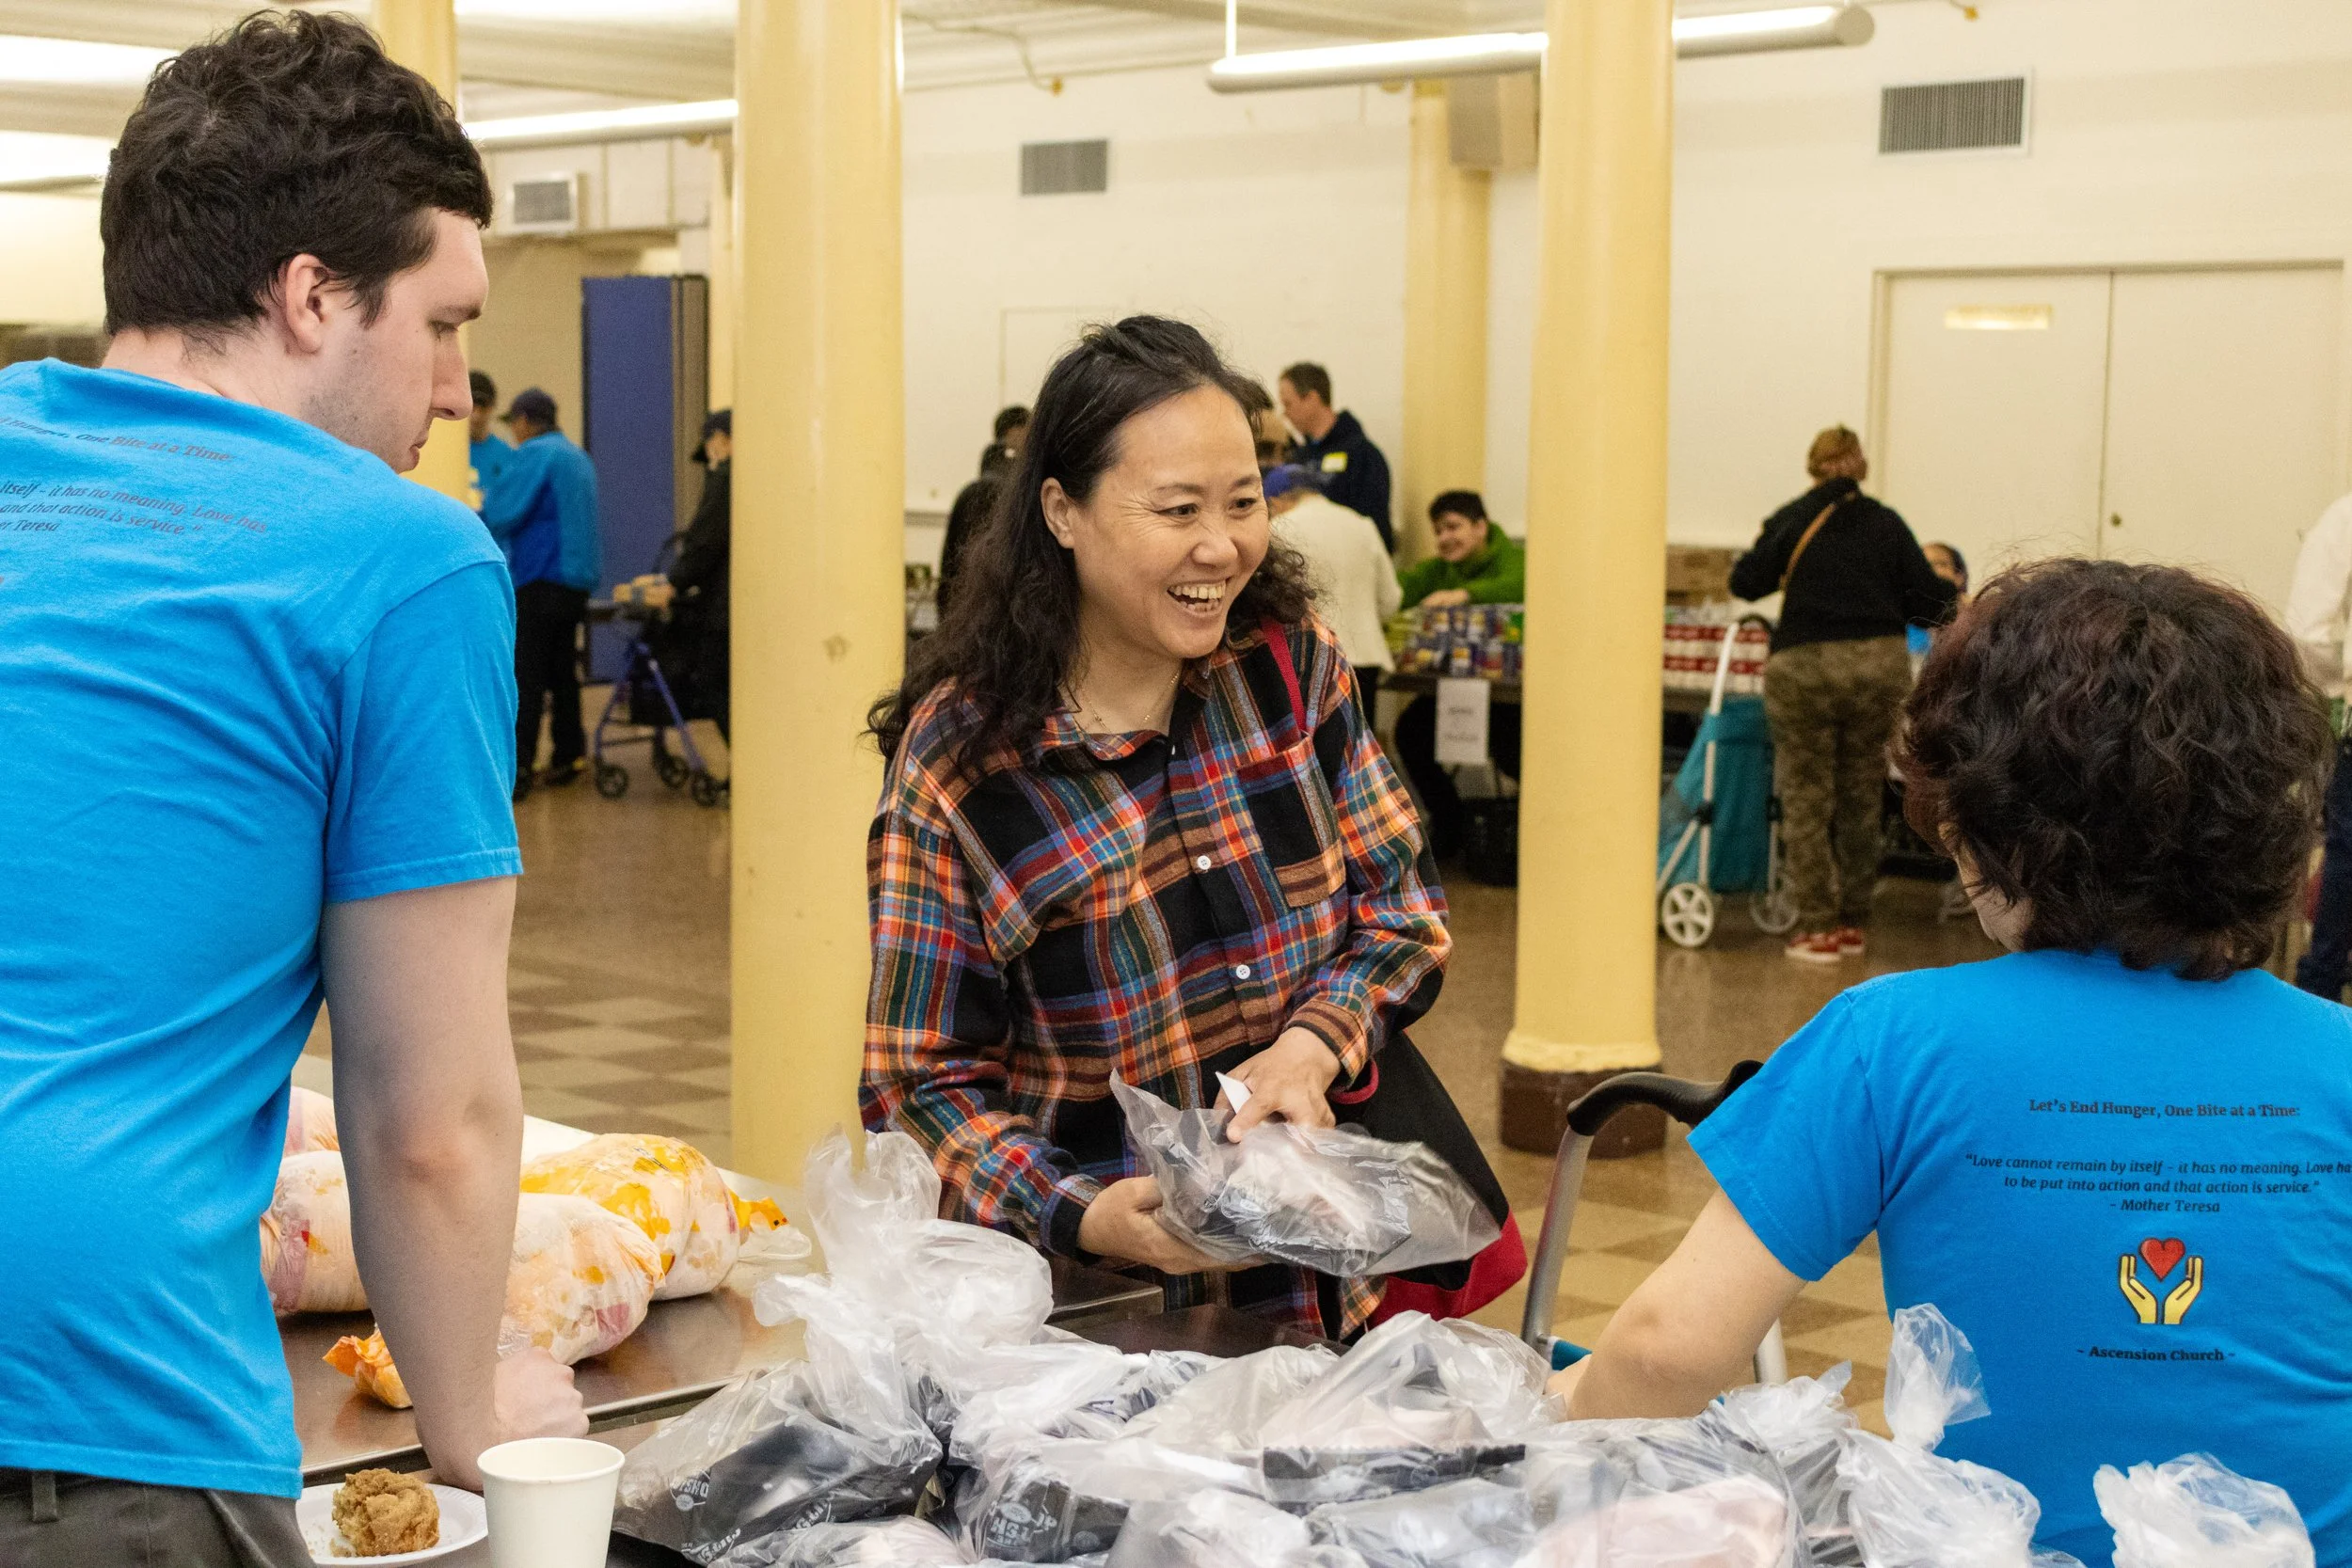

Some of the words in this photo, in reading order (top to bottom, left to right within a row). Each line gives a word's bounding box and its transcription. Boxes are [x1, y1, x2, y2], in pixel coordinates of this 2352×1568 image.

[110, 436, 146, 448] Bite
[147, 442, 167, 451] at
[167, 445, 180, 453] a
[0, 481, 40, 499] itself
[48, 485, 63, 497] it
[61, 485, 88, 497] has
[87, 488, 110, 499] no
[192, 504, 234, 523] Love
[237, 516, 267, 533] has
[0, 502, 30, 514] and
[26, 501, 58, 514] that
[58, 503, 107, 519] action
[108, 509, 123, 523] is
[13, 519, 61, 531] Teresa
[2070, 1101, 2099, 1114] End
[2101, 1101, 2161, 1118] Hunger,
[2164, 1104, 2193, 1117] One
[2196, 1104, 2227, 1117] Bite
[2230, 1105, 2245, 1117] at
[2247, 1108, 2256, 1117] a
[2258, 1104, 2300, 1117] Time:
[2005, 1158, 2054, 1170] cannot
[2056, 1159, 2106, 1172] remain
[2110, 1160, 2126, 1176] by
[2129, 1160, 2164, 1176] itself
[2178, 1162, 2188, 1174] it
[2191, 1162, 2216, 1174] has
[2219, 1164, 2237, 1174] no
[2241, 1162, 2302, 1177] meaning.
[2306, 1162, 2333, 1174] Love
[2336, 1162, 2352, 1175] ha
[2004, 1176, 2018, 1187] to
[2021, 1176, 2037, 1188] be
[2040, 1179, 2063, 1193] put
[2067, 1179, 2095, 1191] into
[2099, 1180, 2140, 1192] action
[2143, 1180, 2170, 1193] and
[2173, 1180, 2202, 1194] that
[2205, 1180, 2249, 1194] action
[2251, 1180, 2263, 1194] is
[2121, 1198, 2171, 1212] Mother
[2174, 1199, 2221, 1212] Teresa
[2089, 1346, 2167, 1361] Ascension
[2169, 1349, 2224, 1361] Church
